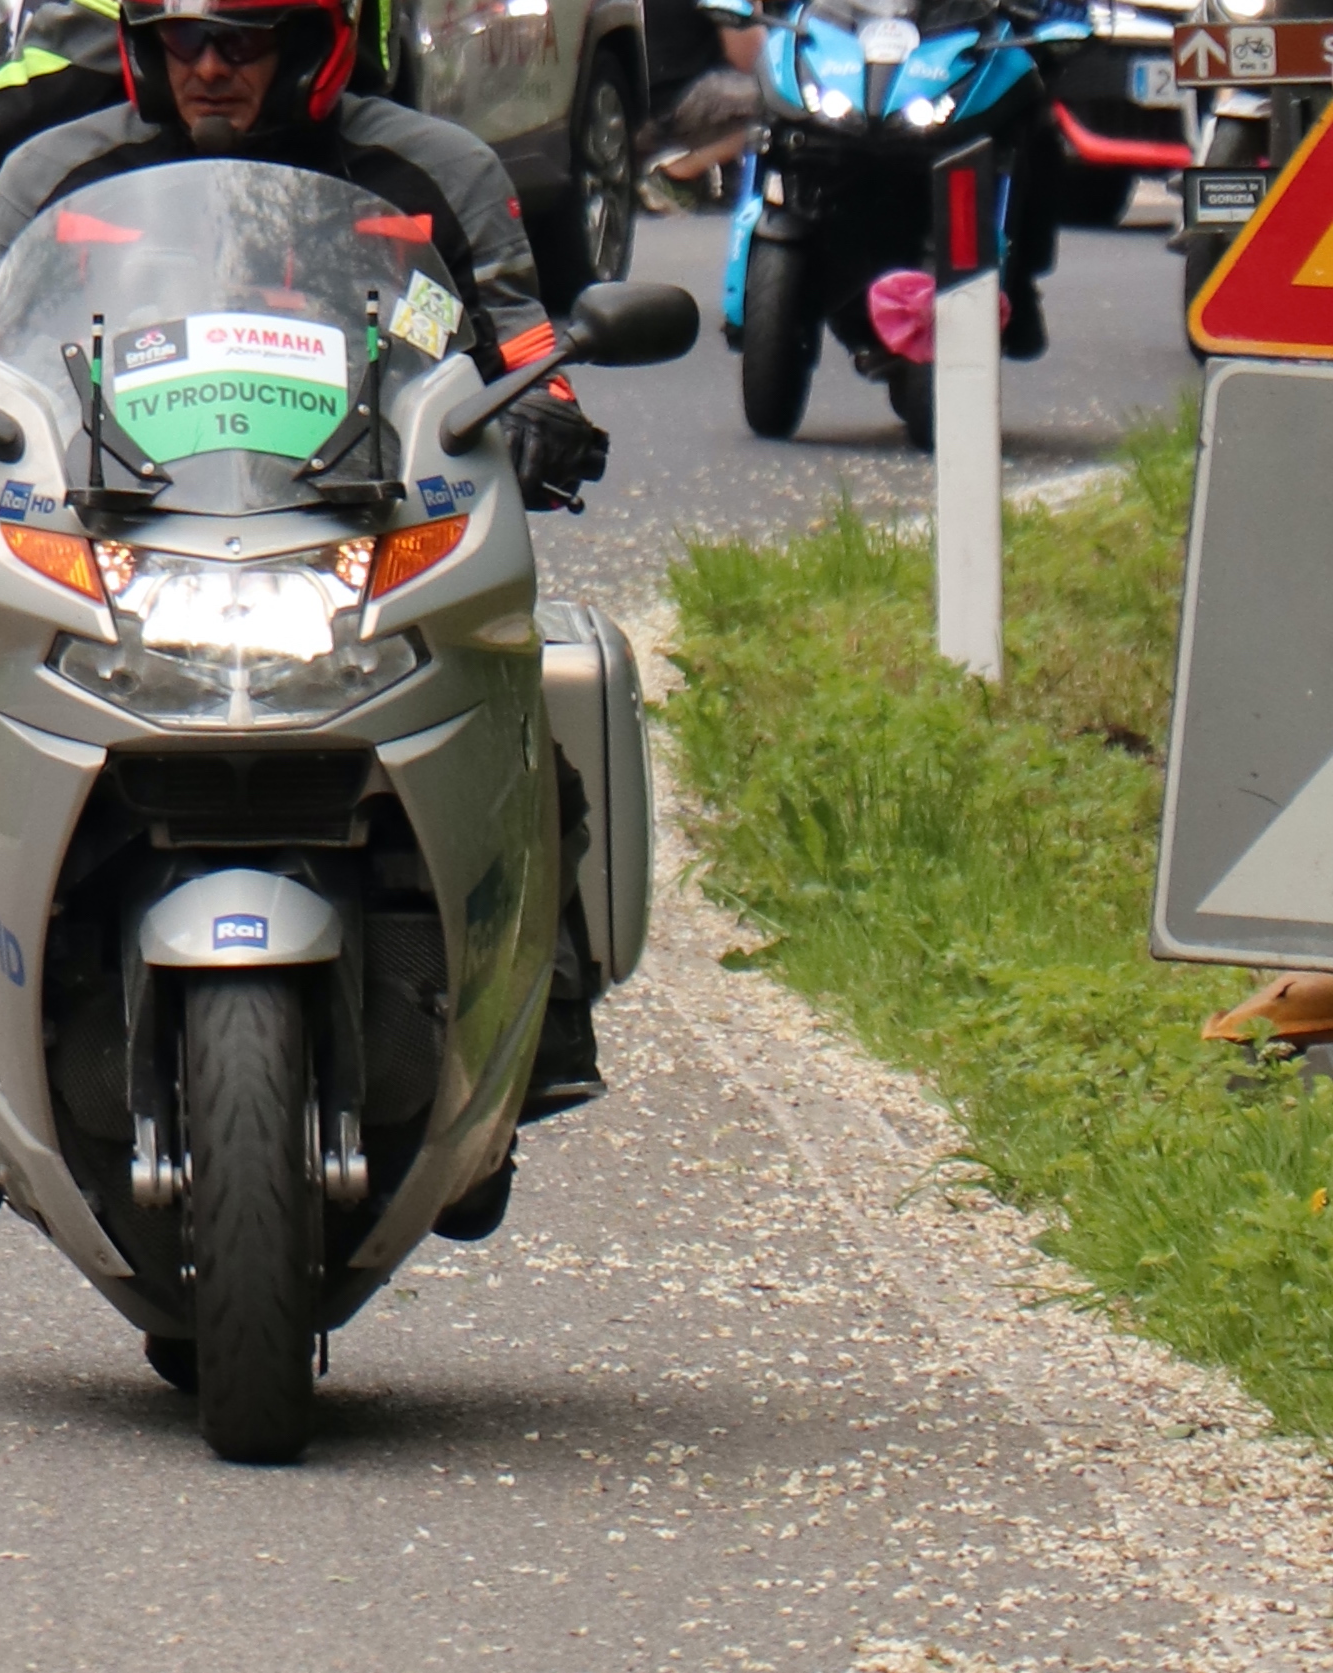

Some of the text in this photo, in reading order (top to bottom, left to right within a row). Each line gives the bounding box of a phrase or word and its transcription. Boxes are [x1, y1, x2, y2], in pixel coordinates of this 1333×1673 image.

[1207, 193, 1255, 205] GORIZIA
[232, 328, 326, 356] YAMAHA
[127, 381, 337, 422] TV PRODUCTION
[215, 413, 250, 435] 16
[0, 489, 56, 514] Rai HD
[422, 480, 476, 507] Rai HD
[217, 922, 264, 940] Rai
